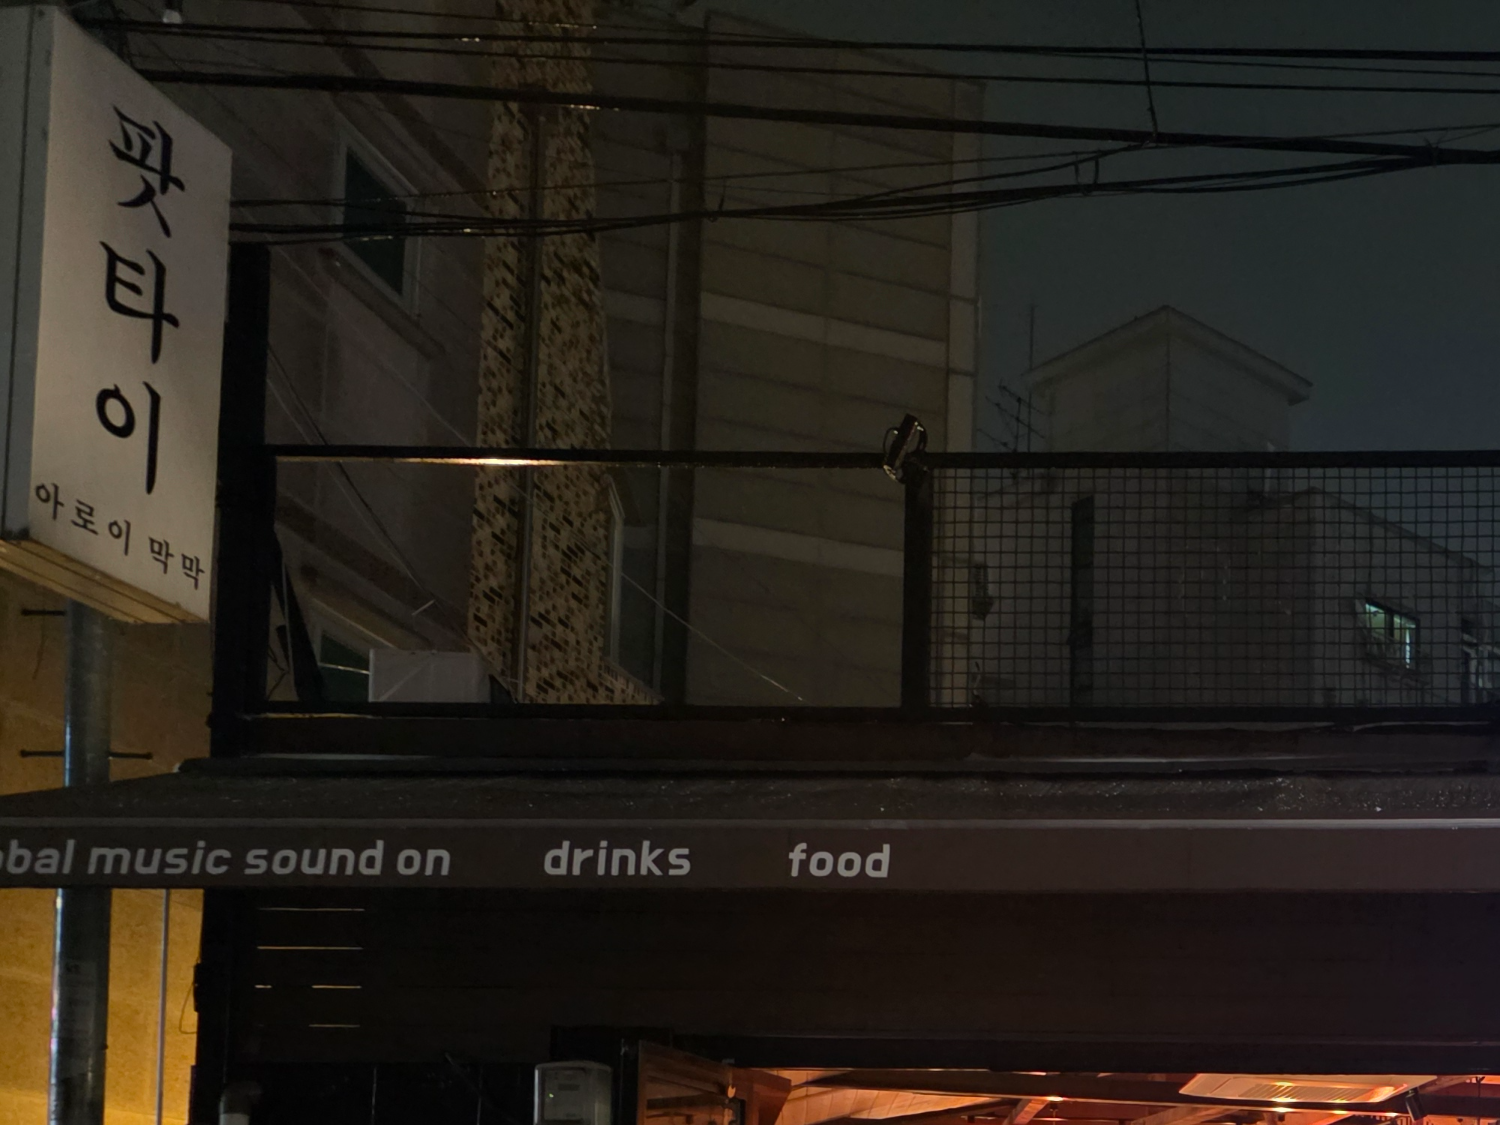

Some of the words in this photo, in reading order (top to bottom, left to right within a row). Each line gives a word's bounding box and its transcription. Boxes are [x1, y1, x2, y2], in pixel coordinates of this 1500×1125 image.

[97, 105, 186, 495] 팟타이
[36, 482, 132, 556] 아로이
[149, 538, 206, 591] 막막
[0, 839, 77, 875] bal
[87, 841, 231, 875] music
[244, 840, 384, 876] sound
[396, 848, 450, 876] on
[545, 841, 691, 875] drinks
[789, 843, 890, 877] food
